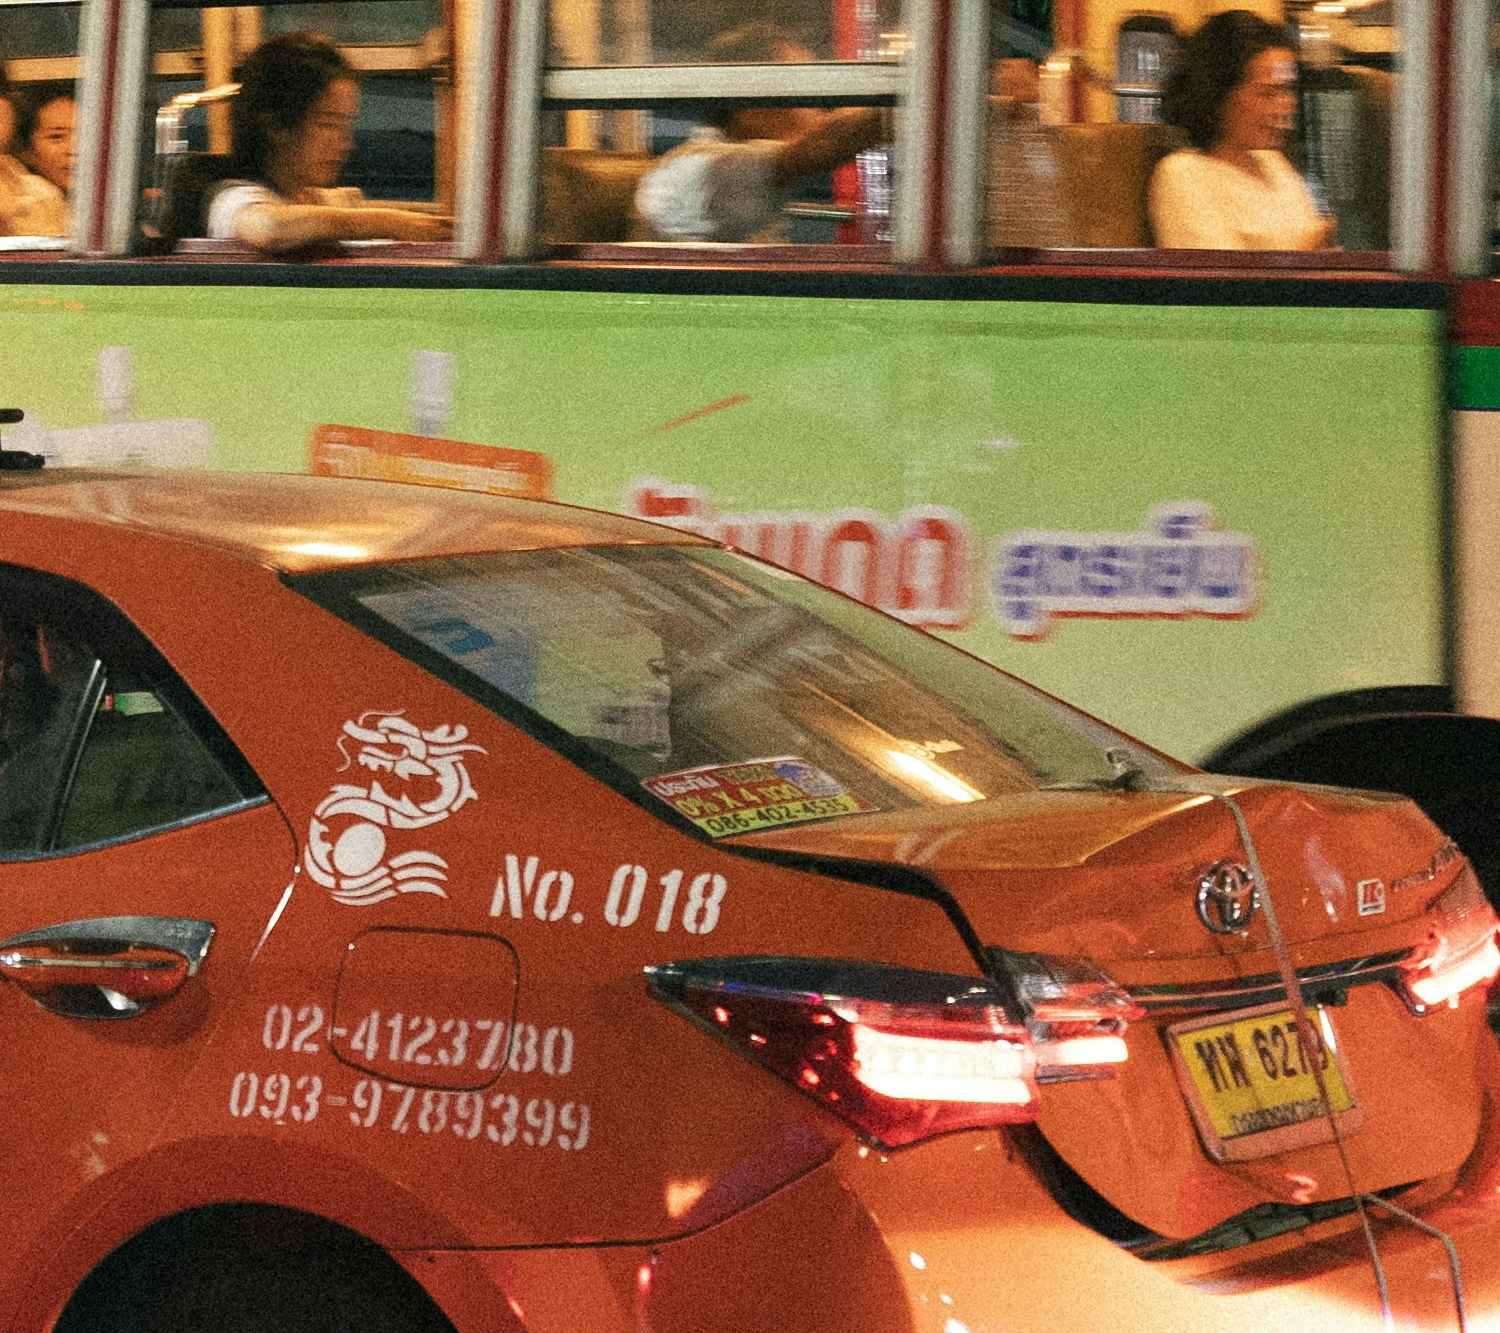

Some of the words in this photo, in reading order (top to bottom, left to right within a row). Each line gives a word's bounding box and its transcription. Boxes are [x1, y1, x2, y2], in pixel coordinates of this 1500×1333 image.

[675, 797, 719, 818] 0%
[743, 786, 761, 804] 4
[489, 853, 584, 923] No.
[604, 863, 728, 934] 018
[262, 1003, 575, 1076] 02-4123780
[228, 1071, 592, 1150] 093-9789399
